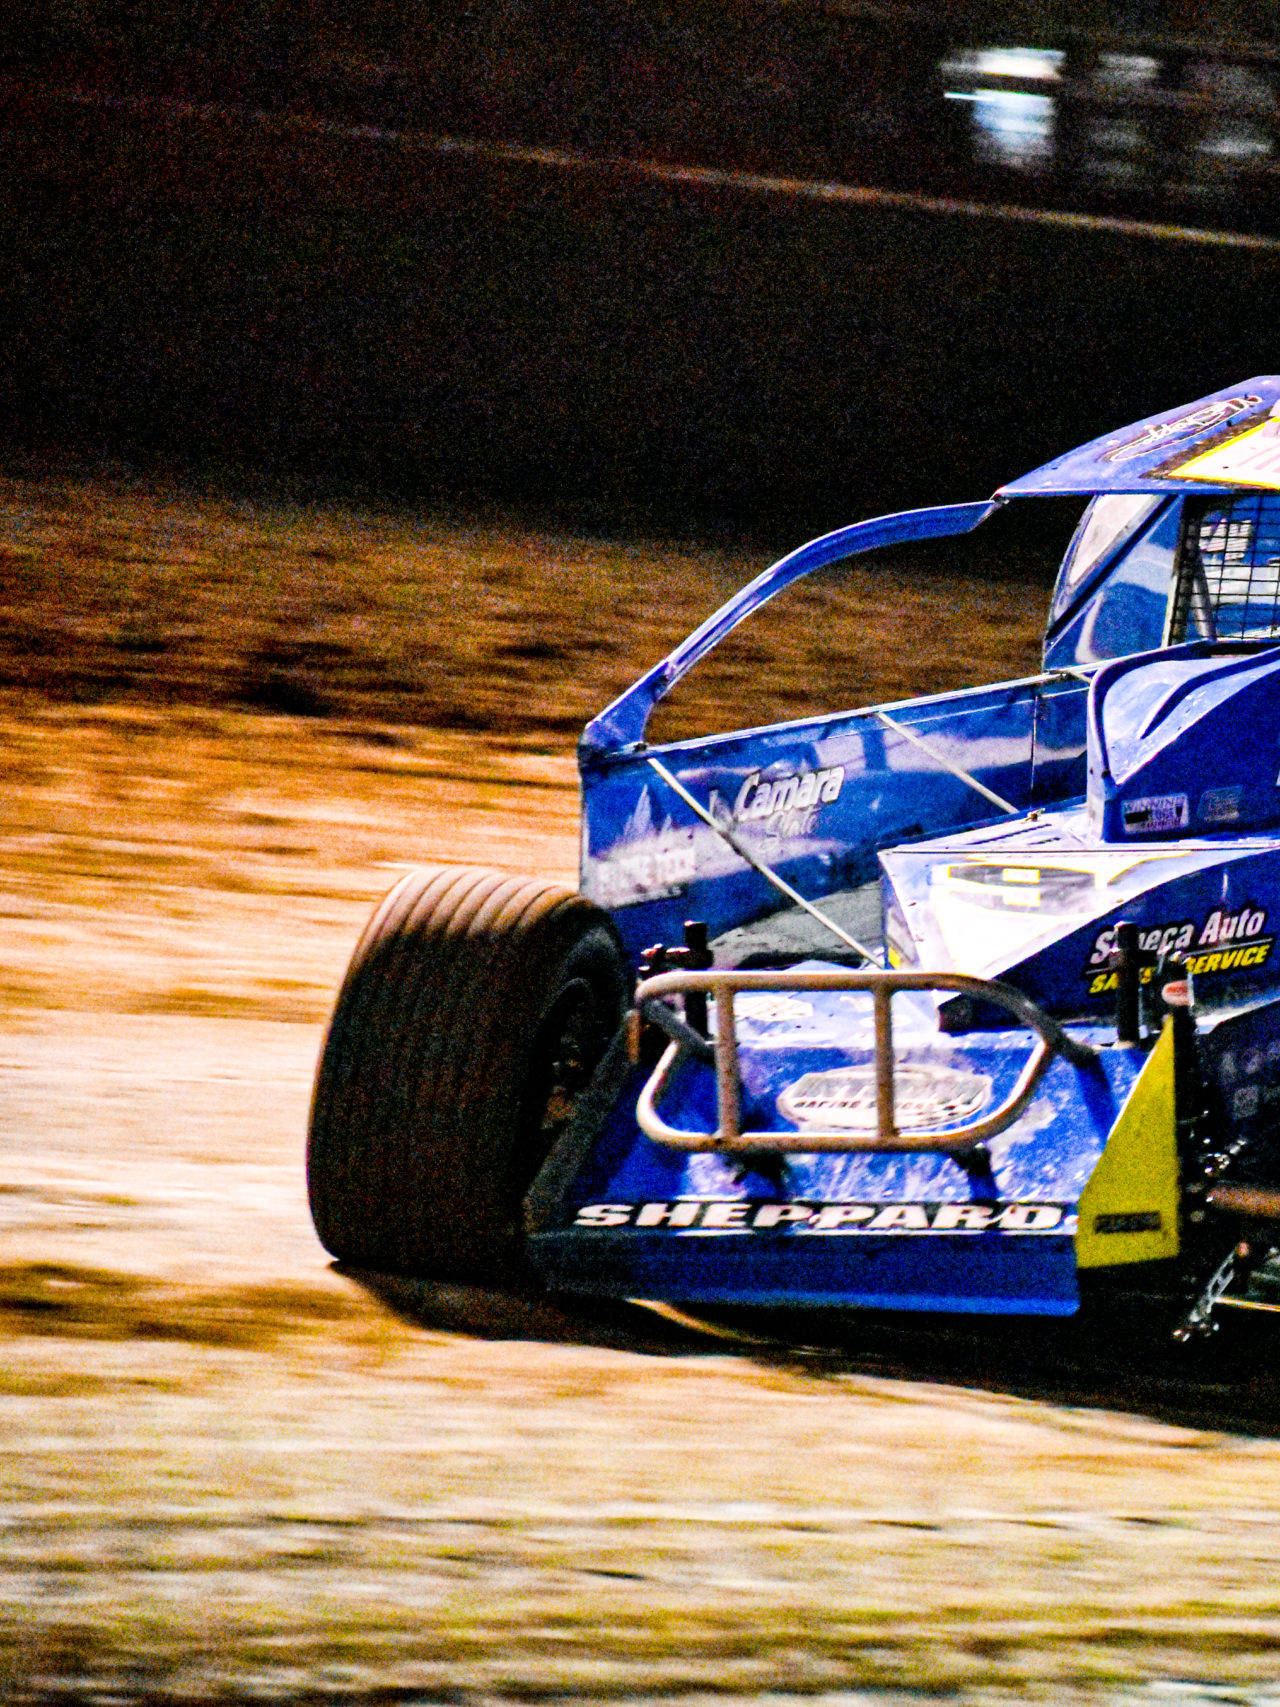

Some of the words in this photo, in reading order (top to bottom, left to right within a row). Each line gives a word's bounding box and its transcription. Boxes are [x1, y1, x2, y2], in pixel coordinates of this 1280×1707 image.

[735, 766, 845, 822] Camara
[1090, 922, 1195, 965] Sneca
[1199, 908, 1266, 945] Auto
[574, 1202, 1063, 1228] SHEPPARD
